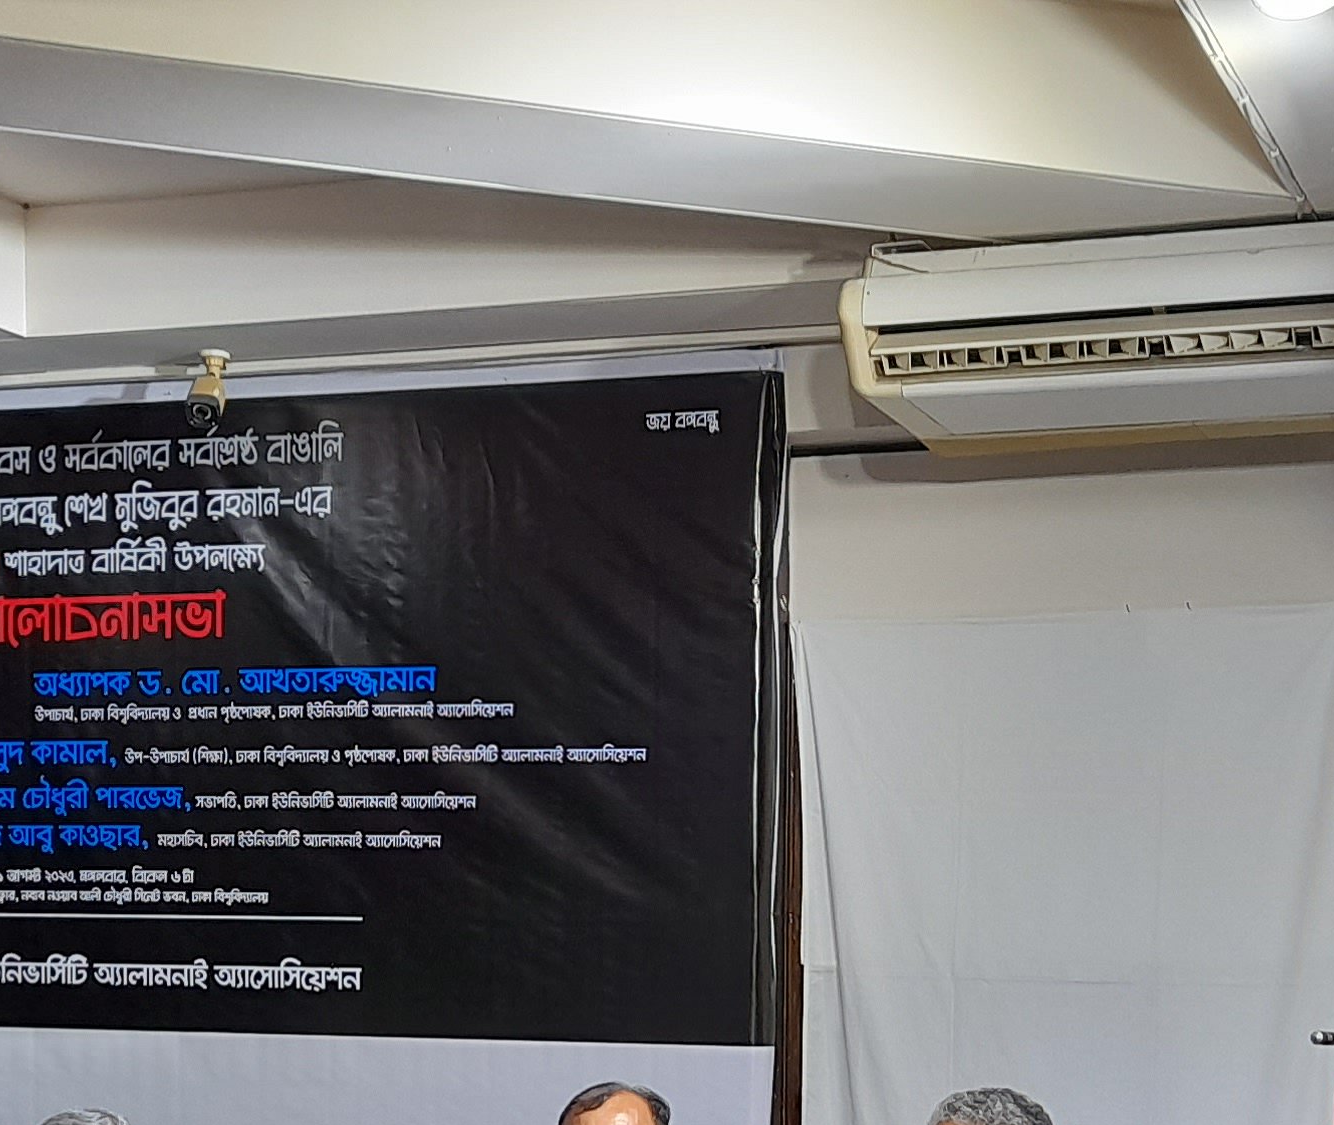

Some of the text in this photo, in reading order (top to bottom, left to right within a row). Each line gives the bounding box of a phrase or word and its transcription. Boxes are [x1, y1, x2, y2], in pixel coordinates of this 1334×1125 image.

[646, 411, 719, 433] জয় বঙ্গবন্ধু
[39, 450, 56, 472] ও
[65, 430, 171, 472] সর্বকালের
[178, 426, 258, 469] সর্বশ্রেষ্ঠ
[266, 420, 344, 463] বাঙালি
[65, 493, 107, 526] শেখ
[115, 480, 199, 532] মুজিবুর
[206, 486, 333, 520] রহমান-এর
[4, 549, 85, 576] শাহাদাত
[91, 537, 167, 573] বার্ষিকী
[34, 672, 131, 696] অধ্যাপক
[239, 667, 436, 697] আখতারুজ্জামান
[81, 708, 104, 721] ঢাকা
[107, 703, 170, 724] বিশ্ববিদ্যালয়
[173, 707, 181, 719] ও
[189, 707, 217, 719] প্রধান
[279, 706, 303, 718] ঢাকা
[372, 701, 433, 718] অ্যালামনাই
[31, 741, 116, 767] কামাল,
[236, 751, 260, 763] ঢাকা
[264, 745, 329, 766] বিশ্ববিদ্যালয়
[332, 750, 340, 762] ও
[403, 749, 428, 762] ঢাকা
[502, 746, 563, 763] অ্যালামনাই
[23, 776, 89, 816] চৌধুরী
[96, 787, 191, 811] পারভেজ,
[195, 791, 240, 809] সভাপতি,
[244, 796, 268, 808] ঢাকা
[337, 793, 397, 809] অ্যালামনাই
[8, 825, 53, 853] আবু
[59, 825, 148, 850] কাওছার,
[211, 834, 234, 846] ঢাকা
[303, 831, 362, 848] অ্যালামনাই
[93, 959, 208, 989] অ্যালামনাই
[214, 958, 362, 991] অ্যাসোসিয়েশন
